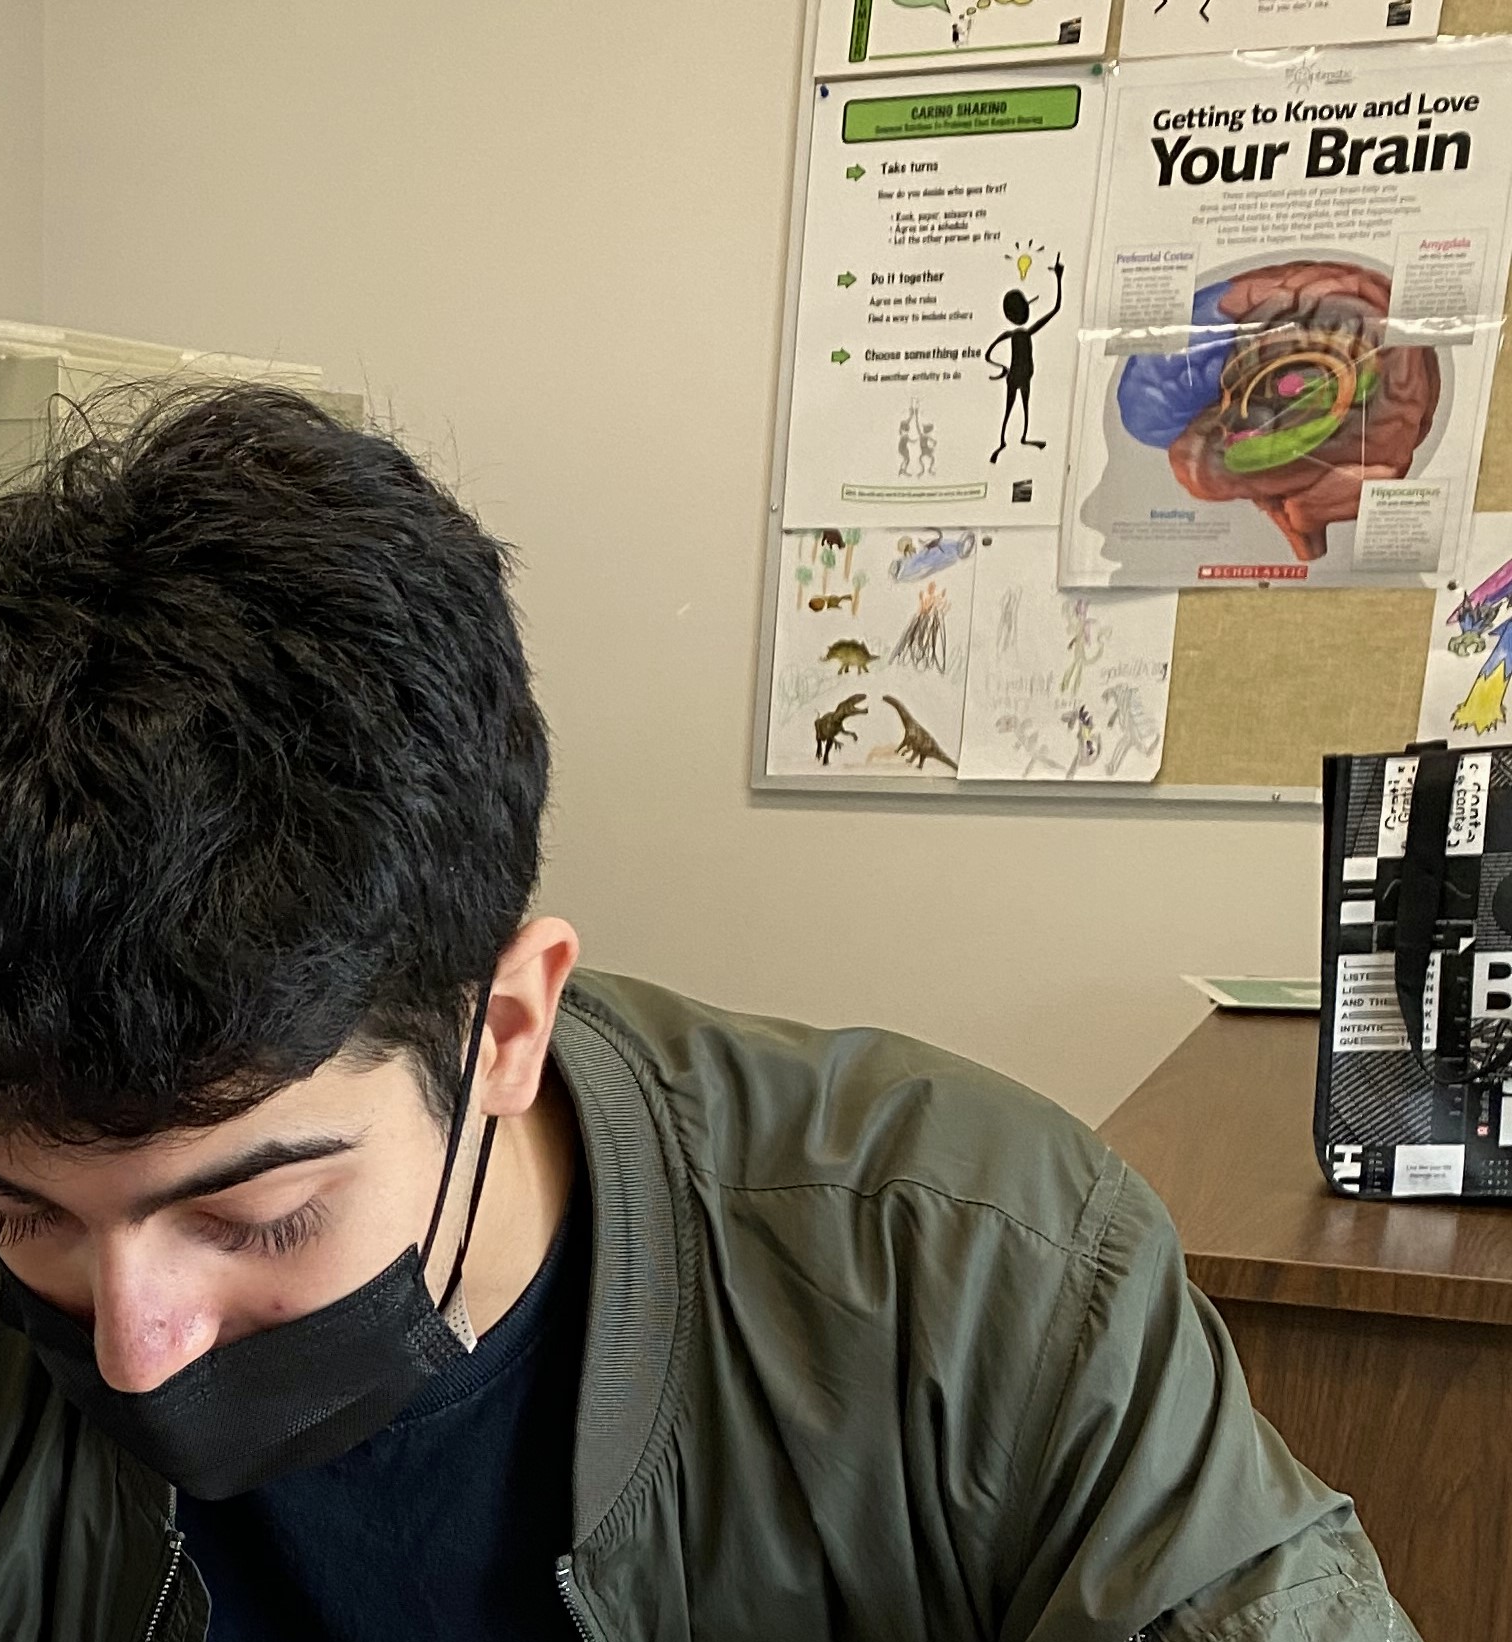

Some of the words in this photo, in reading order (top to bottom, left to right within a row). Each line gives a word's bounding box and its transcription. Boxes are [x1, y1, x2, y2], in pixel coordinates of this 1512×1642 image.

[1153, 106, 1246, 132] Getting
[1253, 104, 1278, 125] to
[1284, 99, 1358, 122] Know
[1363, 93, 1411, 118] and
[1418, 93, 1479, 115] Love
[1150, 135, 1290, 187] Your
[1305, 118, 1471, 179] Brain
[881, 162, 906, 175] Take
[910, 162, 939, 173] turns
[1420, 237, 1471, 251] Amygdala
[871, 272, 884, 285] Do
[887, 271, 895, 284] it
[899, 269, 944, 285] together
[865, 349, 901, 361] Choose
[904, 346, 958, 361] something
[962, 346, 981, 359] else
[1213, 566, 1305, 578] SCHOLASTIC
[1342, 998, 1364, 1007] AND
